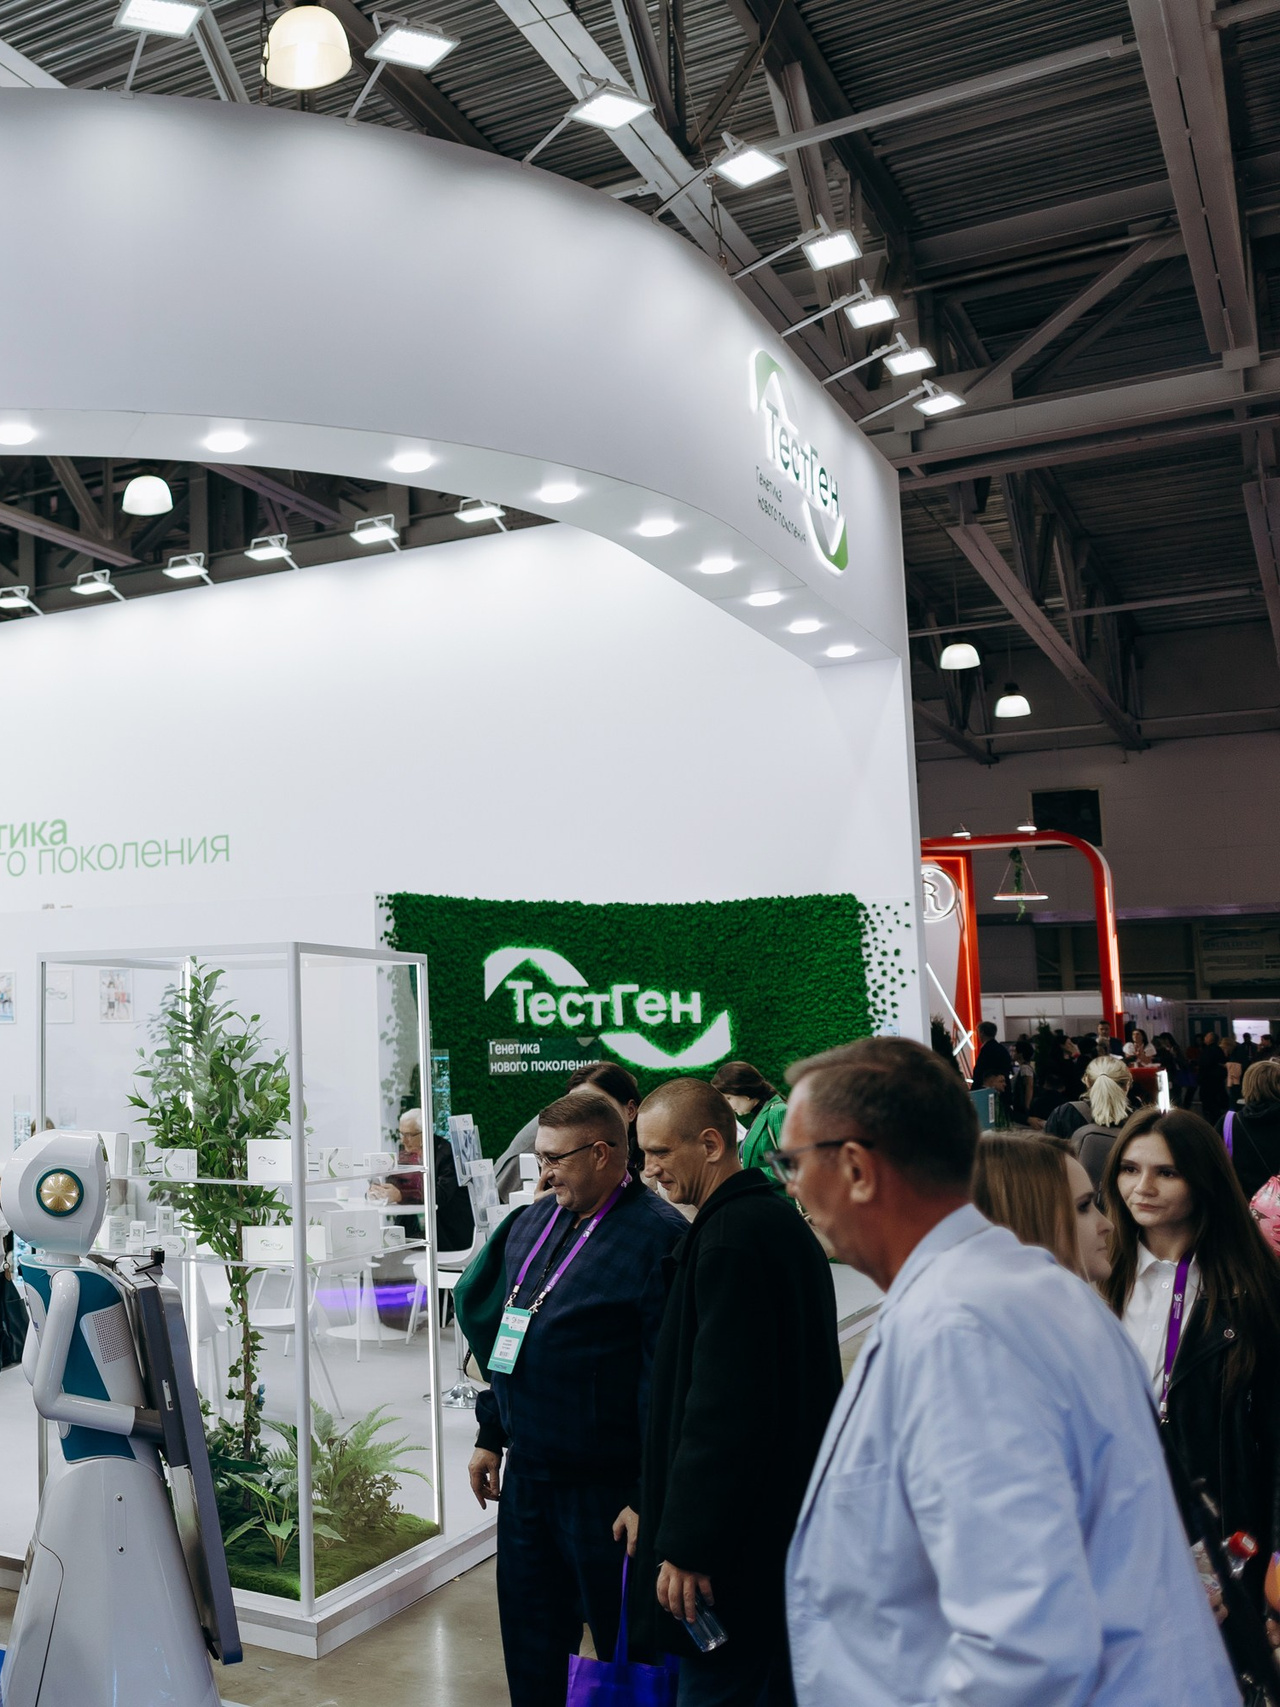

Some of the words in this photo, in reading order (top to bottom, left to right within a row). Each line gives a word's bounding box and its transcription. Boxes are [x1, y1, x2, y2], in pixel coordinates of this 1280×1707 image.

[765, 401, 840, 518] ТестГен
[39, 834, 230, 875] поколения
[506, 981, 701, 1026] ТестГен
[489, 1041, 540, 1055] Генетика
[490, 1060, 529, 1073] нового
